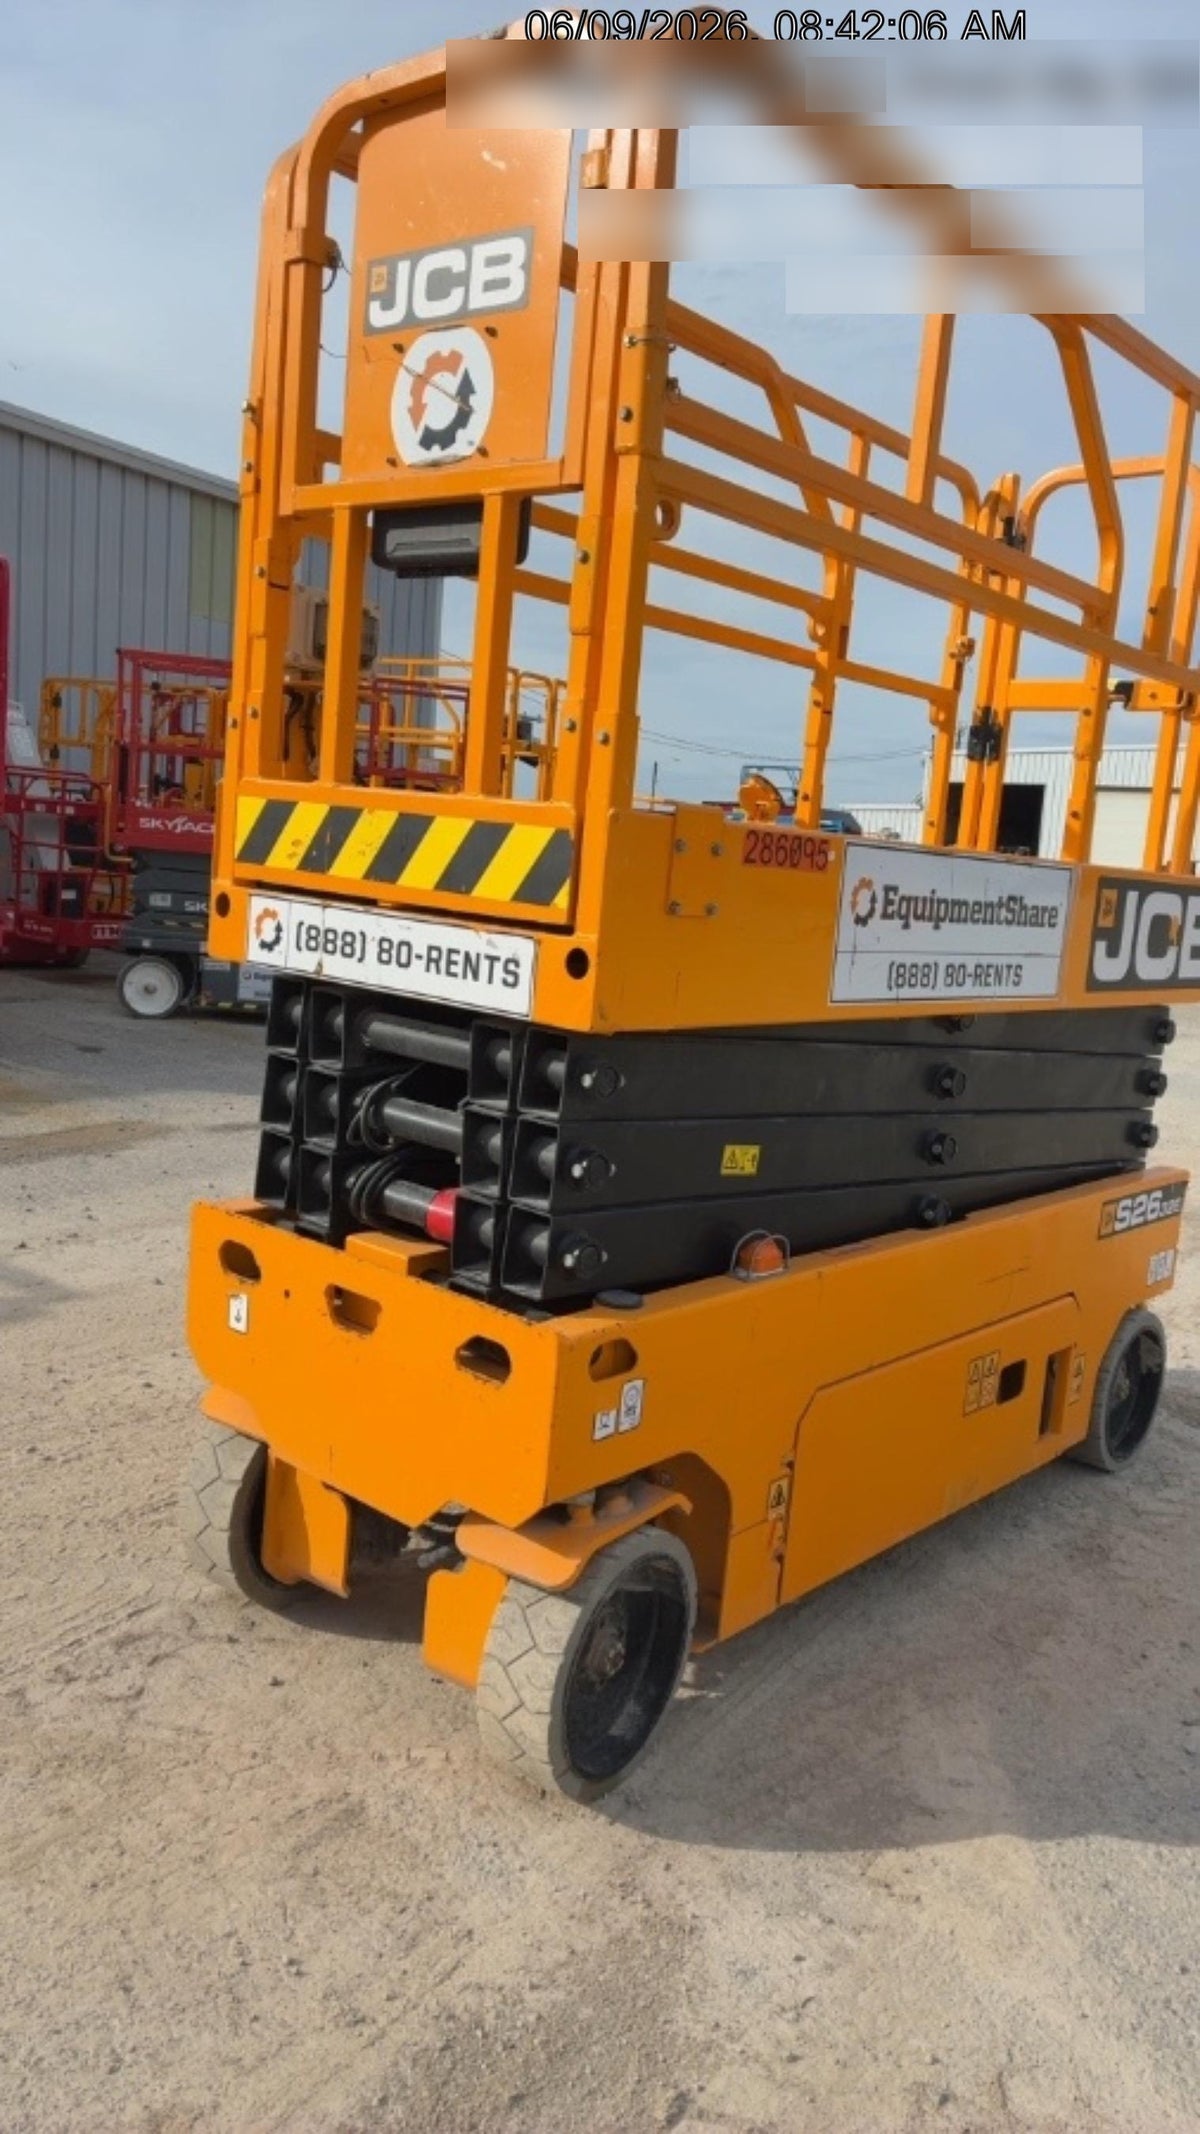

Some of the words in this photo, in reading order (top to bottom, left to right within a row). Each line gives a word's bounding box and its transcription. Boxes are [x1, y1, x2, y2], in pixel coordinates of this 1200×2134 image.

[369, 236, 526, 328] JCB
[743, 829, 830, 871] 286095
[879, 884, 1059, 931] EquipmentShare
[295, 920, 367, 964] (888)
[376, 936, 521, 990] 80-RENTS
[886, 960, 940, 991] (888)
[943, 963, 1024, 988] 80-RENTS
